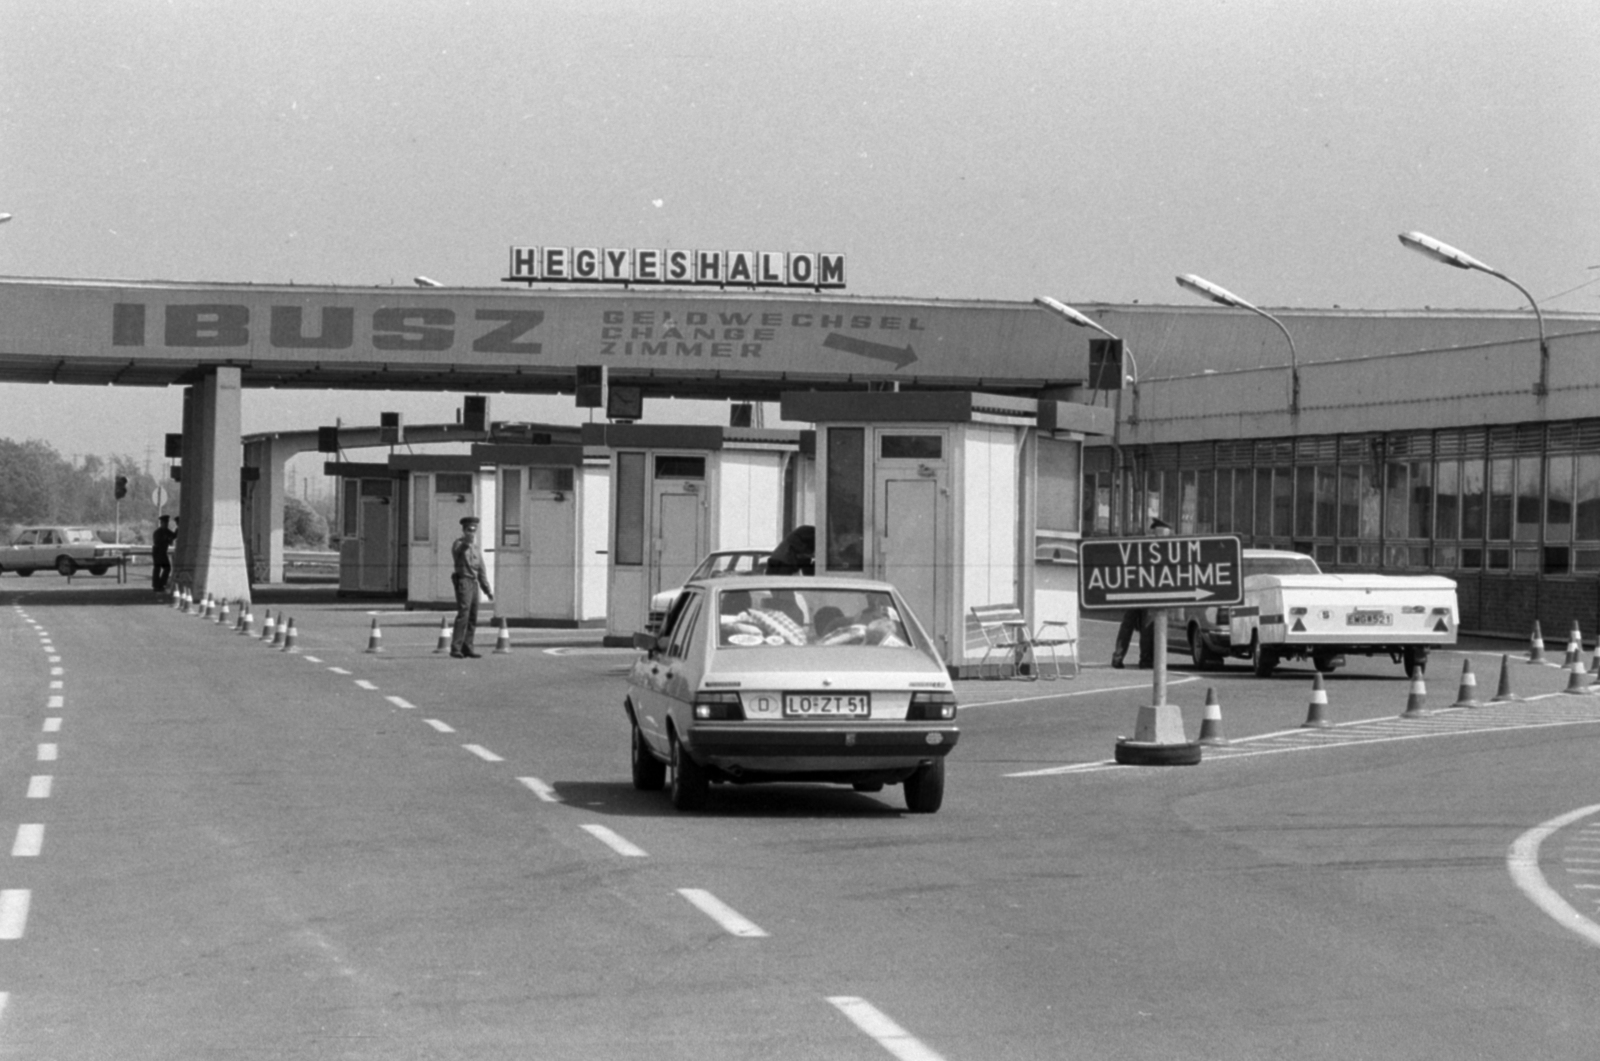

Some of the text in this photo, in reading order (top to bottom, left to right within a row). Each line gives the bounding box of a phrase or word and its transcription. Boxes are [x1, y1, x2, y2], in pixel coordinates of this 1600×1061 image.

[514, 248, 844, 283] HEGYESHALOM
[112, 303, 545, 354] IBUSZ
[602, 310, 925, 331] GELDWECHSEL
[601, 327, 775, 340] CHANGE
[600, 341, 762, 358] ZIMMER
[1118, 541, 1201, 565] VISUM
[1088, 562, 1232, 590] AUFNAHME
[758, 697, 769, 712] D
[848, 697, 865, 713] 51
